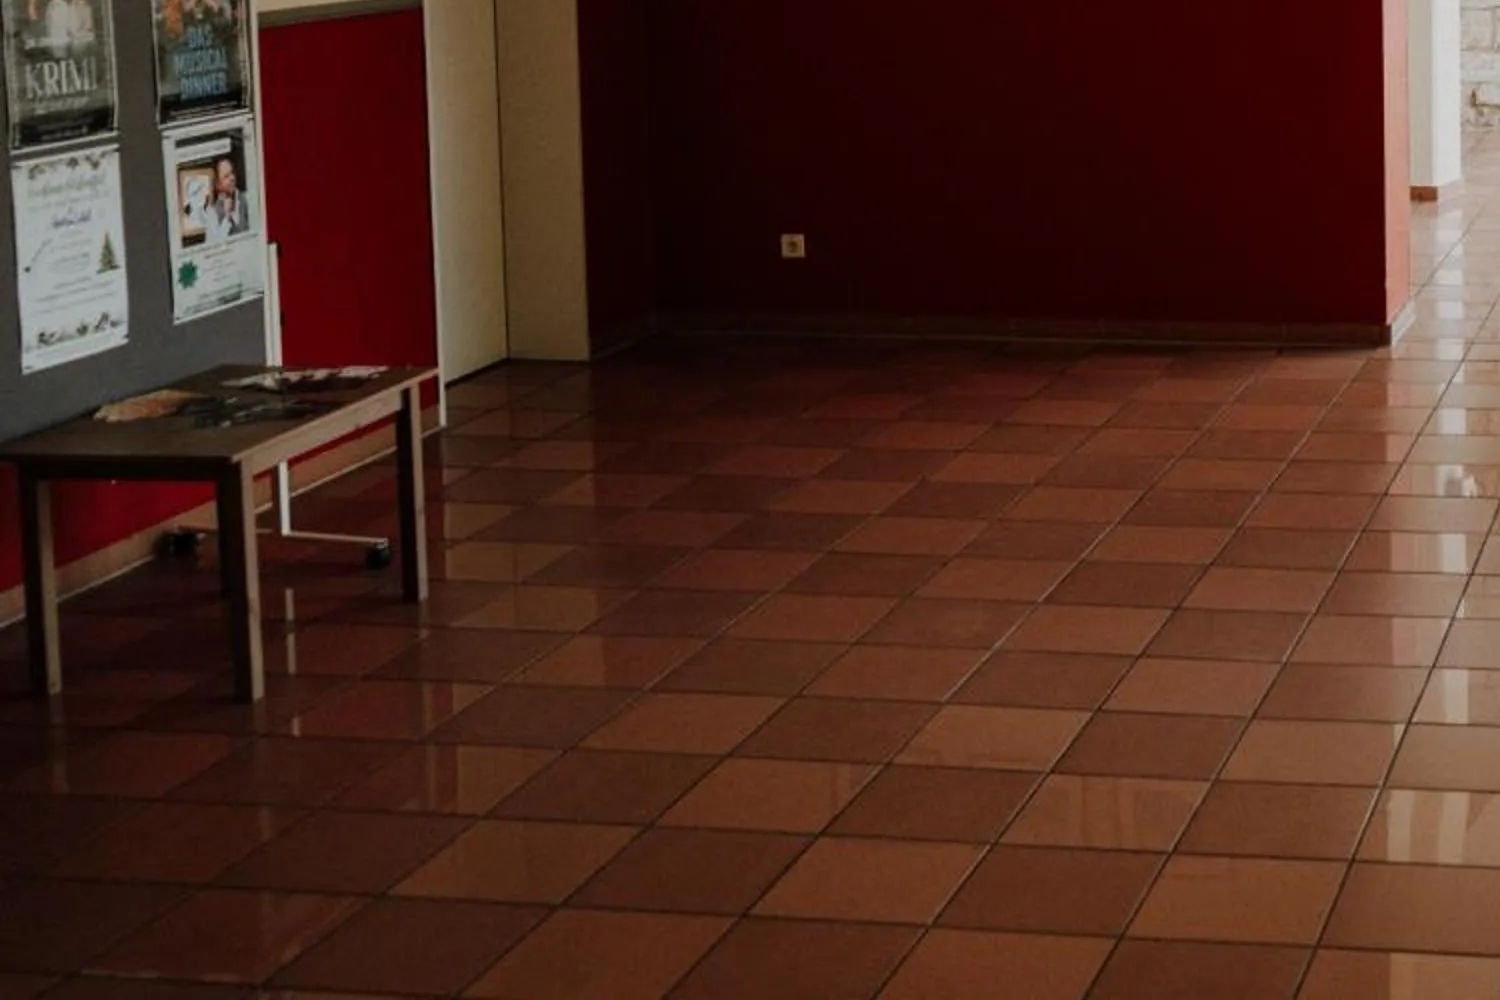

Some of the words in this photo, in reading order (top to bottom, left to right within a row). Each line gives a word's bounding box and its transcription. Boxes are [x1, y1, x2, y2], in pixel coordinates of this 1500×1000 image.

[187, 25, 213, 48] DAS
[174, 49, 229, 74] MUSICAL
[180, 73, 227, 99] DINNER
